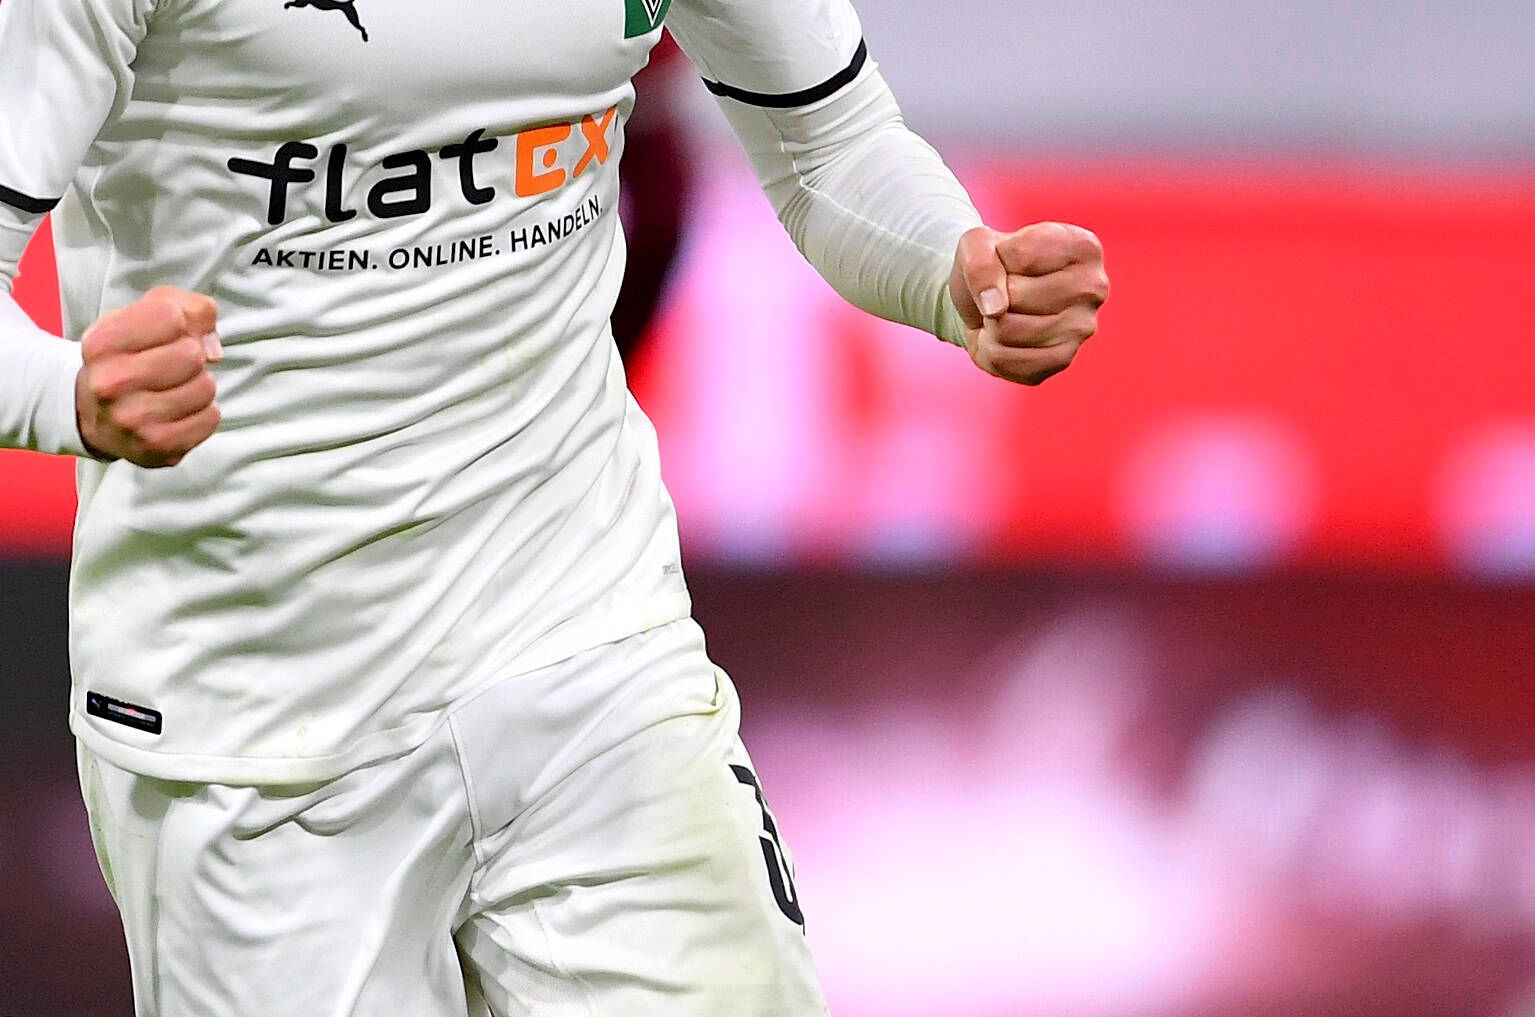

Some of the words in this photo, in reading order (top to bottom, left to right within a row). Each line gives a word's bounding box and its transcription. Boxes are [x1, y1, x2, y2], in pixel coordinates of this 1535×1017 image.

[251, 247, 378, 271] AKTIEN.
[388, 235, 500, 270] ONLINE.
[510, 194, 603, 252] HANDELN.
